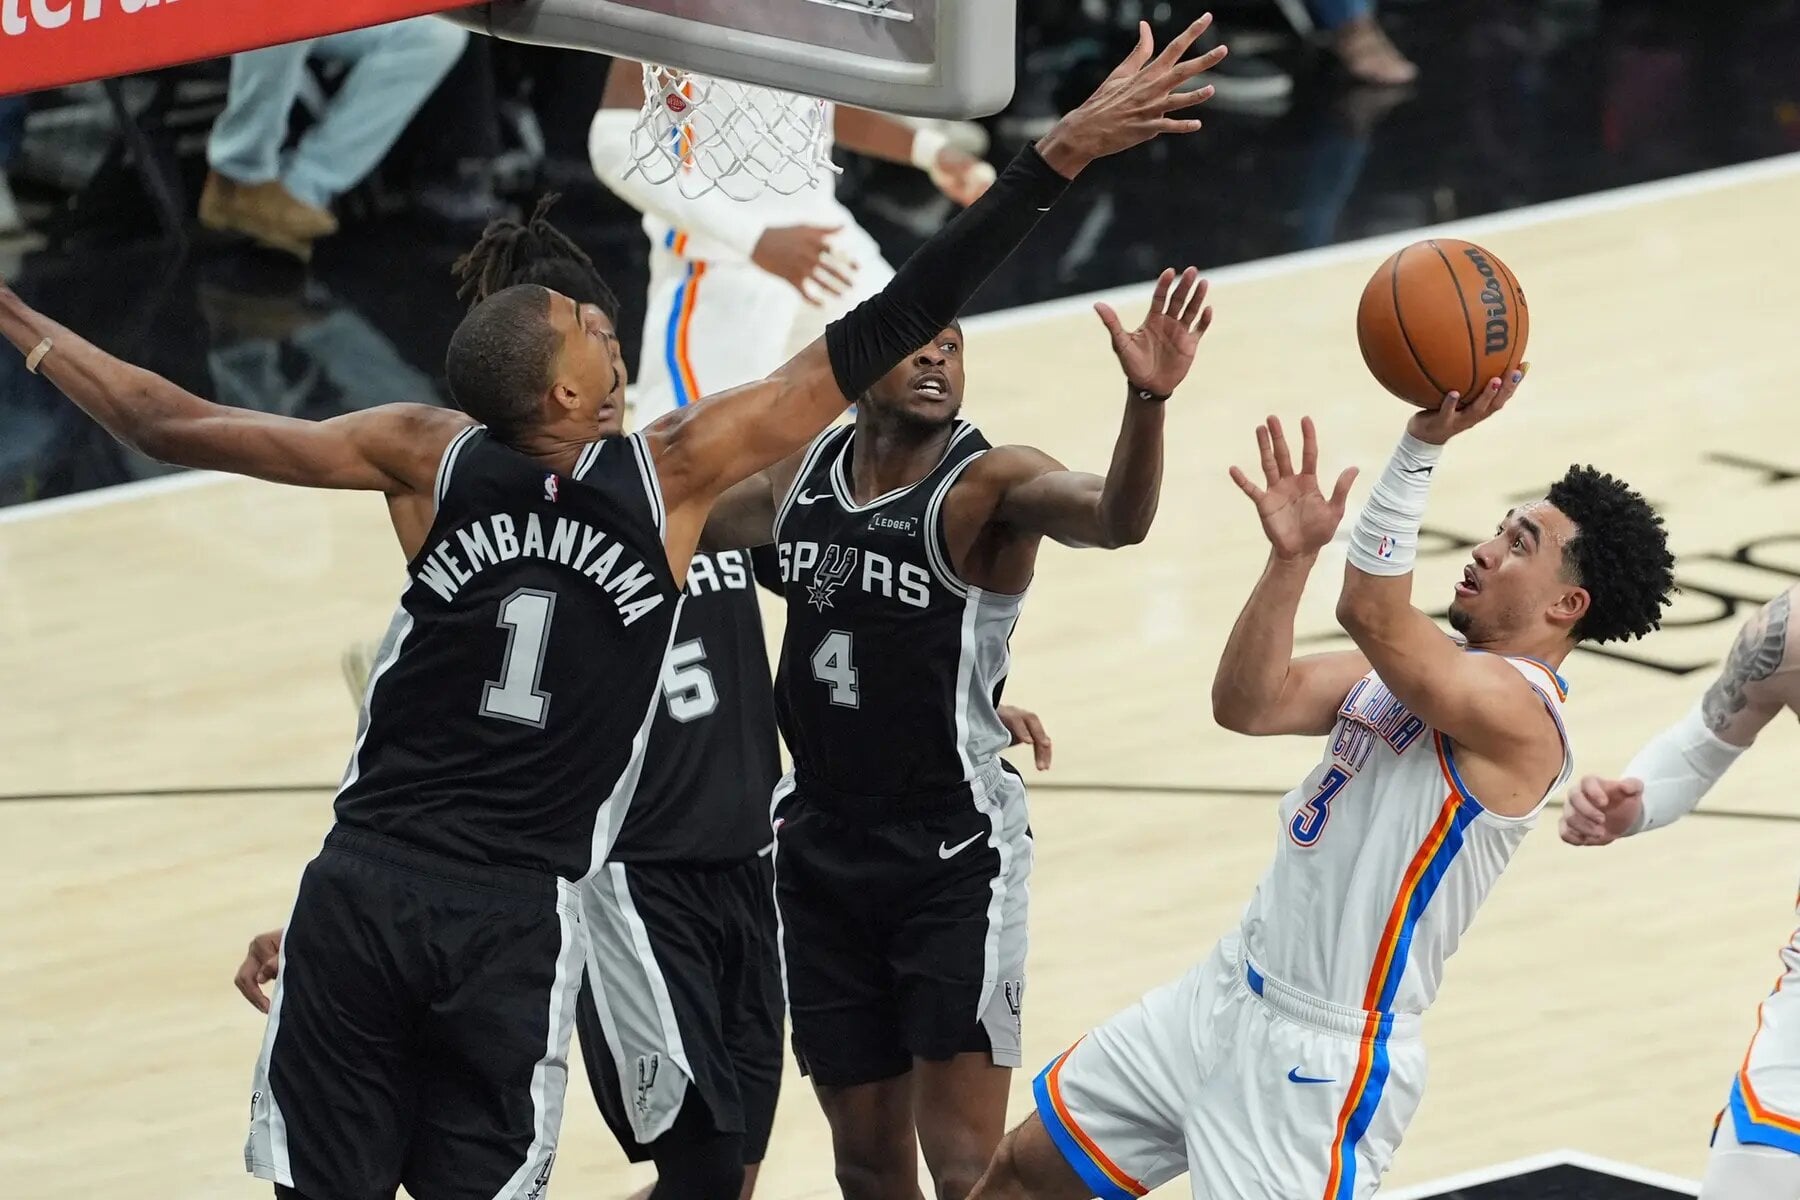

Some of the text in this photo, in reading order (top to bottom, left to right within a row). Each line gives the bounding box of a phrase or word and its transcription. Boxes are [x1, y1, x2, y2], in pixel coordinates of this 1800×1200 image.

[1463, 248, 1509, 357] Wilson
[874, 516, 912, 532] LEDGER
[417, 512, 665, 627] WEMBANYAMA
[778, 541, 931, 614] SPURS
[478, 587, 558, 730] 1
[662, 636, 720, 724] 5
[810, 629, 861, 710] 4
[1288, 763, 1354, 848] 3
